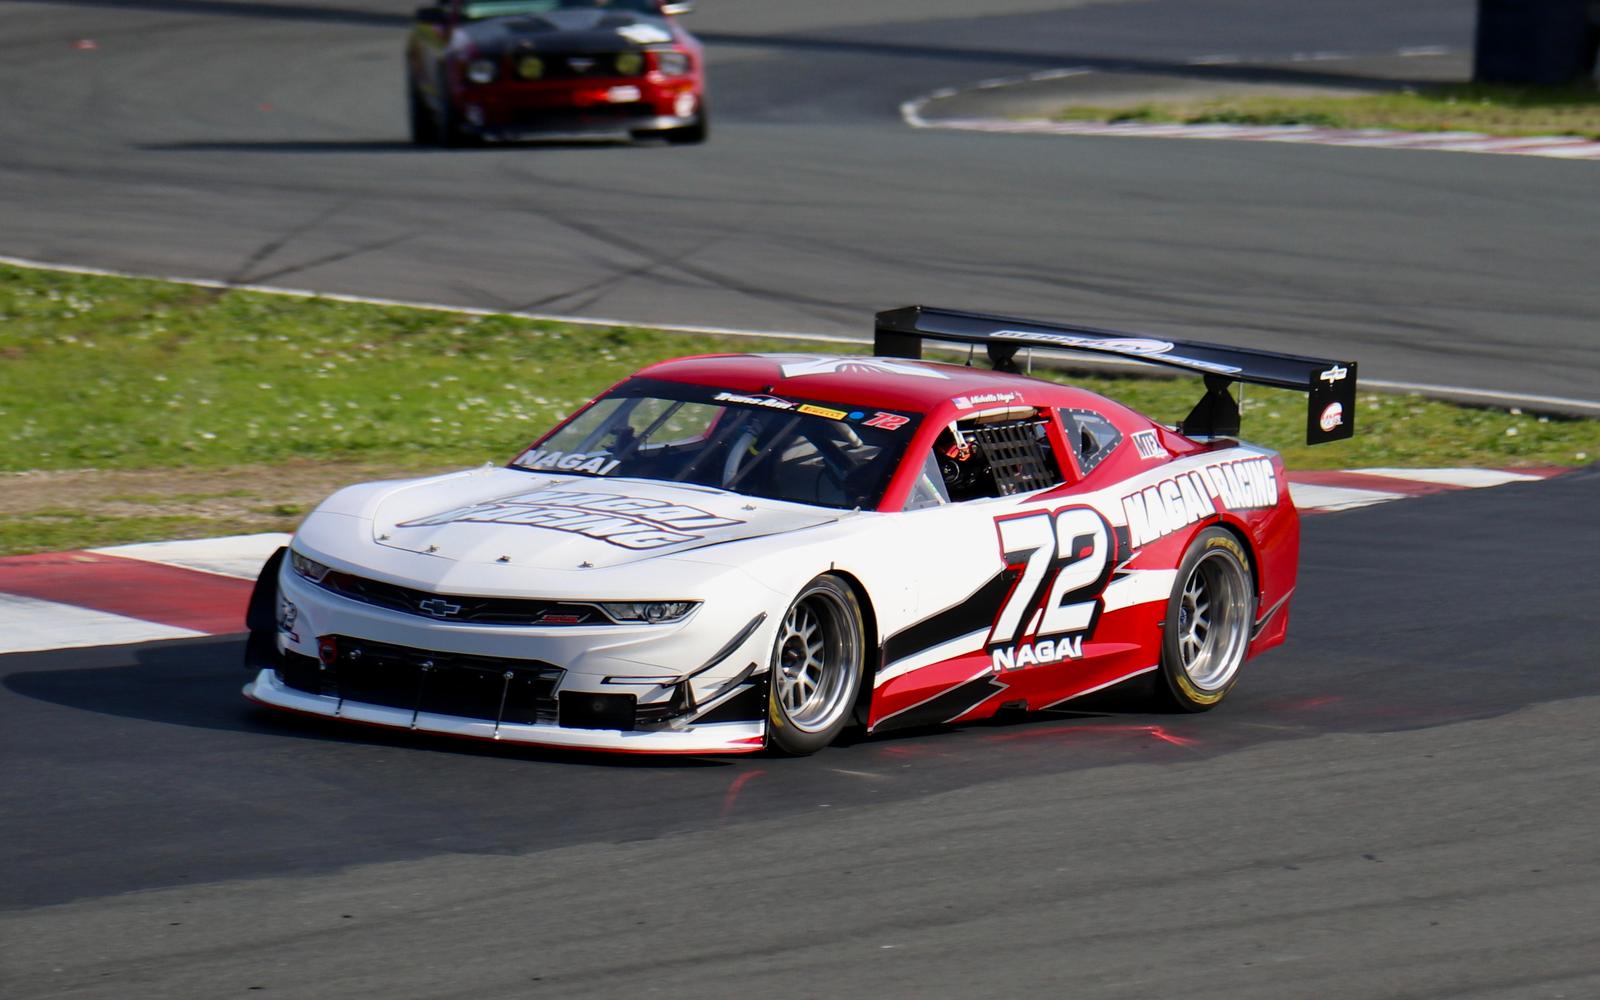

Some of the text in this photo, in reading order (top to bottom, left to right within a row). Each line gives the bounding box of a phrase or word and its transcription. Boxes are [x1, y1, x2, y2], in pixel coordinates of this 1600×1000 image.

[862, 411, 910, 431] 72
[513, 451, 621, 475] NAGAI
[479, 491, 746, 530] NAGAI
[1121, 456, 1279, 549] NAGAI RACING
[990, 504, 1115, 645] 72
[990, 636, 1084, 672] NAGAI
